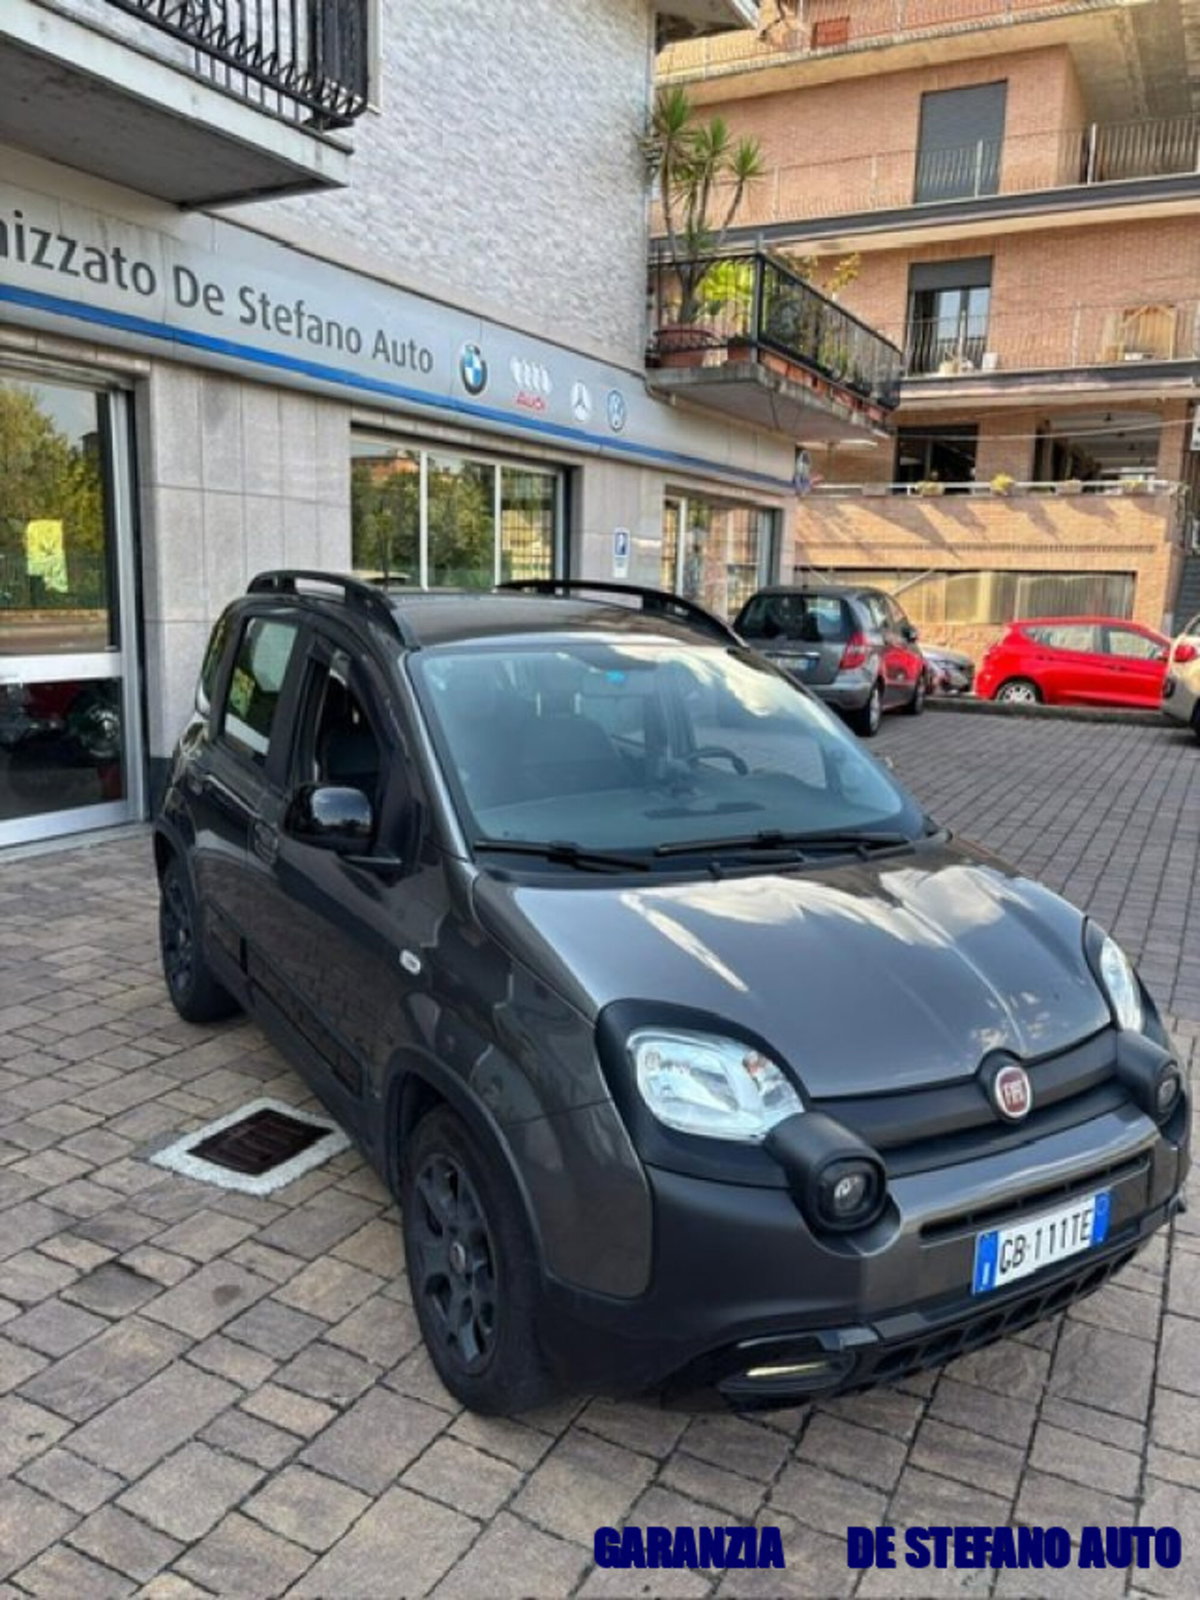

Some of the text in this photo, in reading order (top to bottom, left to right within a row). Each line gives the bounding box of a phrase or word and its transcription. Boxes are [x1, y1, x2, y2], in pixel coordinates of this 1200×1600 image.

[173, 264, 225, 316] De
[239, 285, 362, 355] Stefano
[372, 329, 434, 374] Auto
